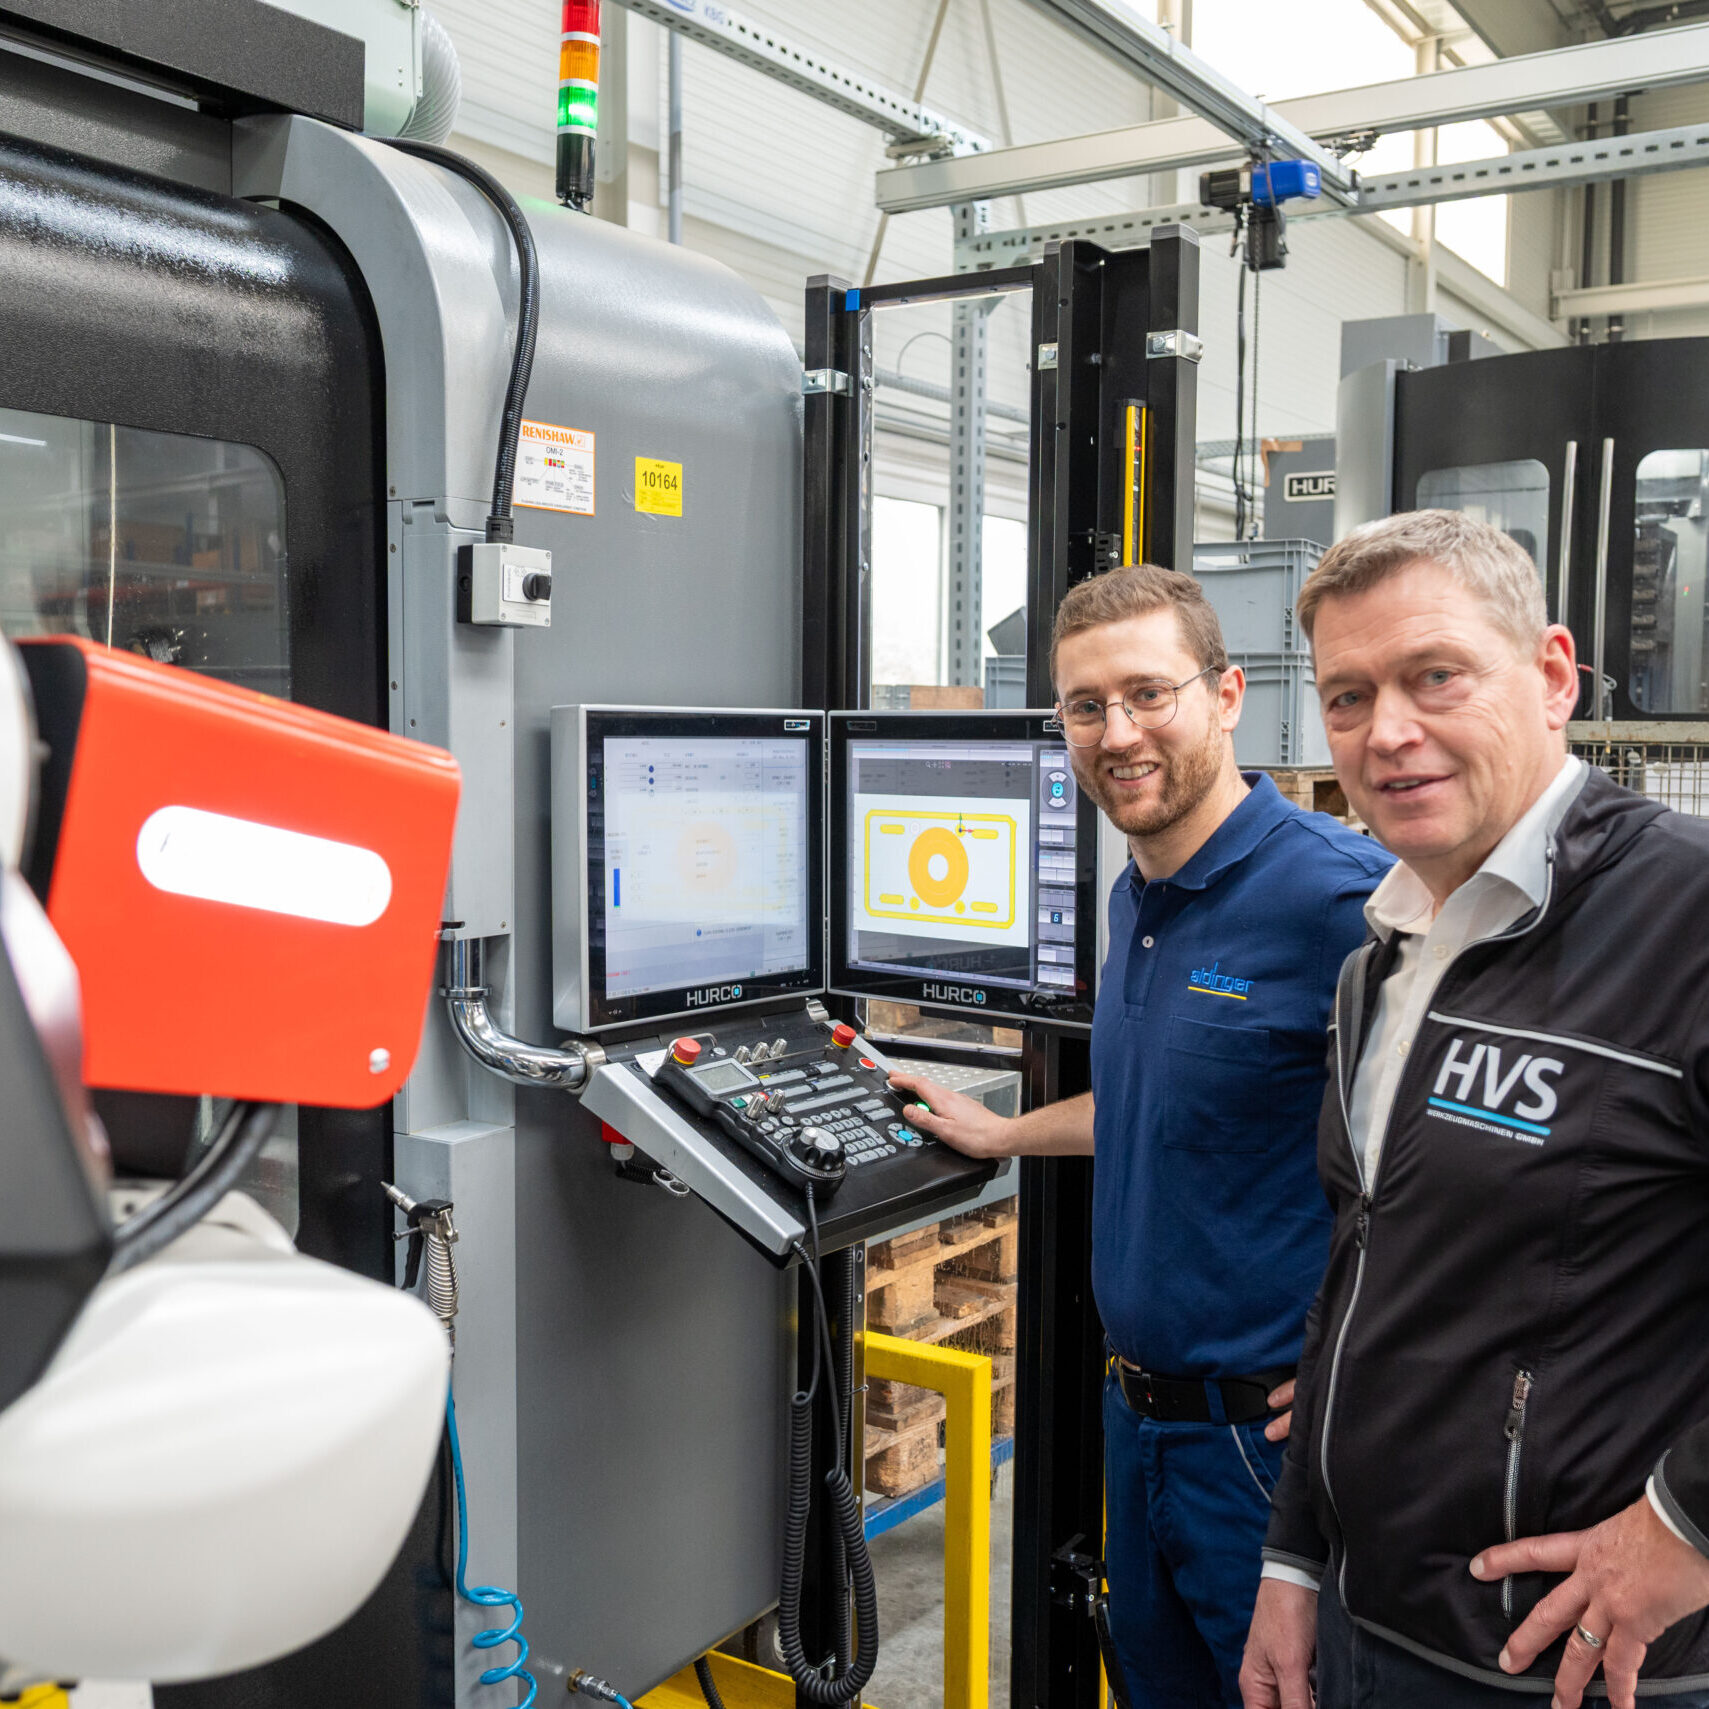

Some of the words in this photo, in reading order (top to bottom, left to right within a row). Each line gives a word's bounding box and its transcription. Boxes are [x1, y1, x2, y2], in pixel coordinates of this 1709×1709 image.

[522, 425, 575, 445] RENISHAW
[642, 470, 678, 491] 10164
[686, 984, 743, 1007] HURCO
[922, 983, 986, 1005] HURCO
[1433, 1038, 1565, 1121] HVS
